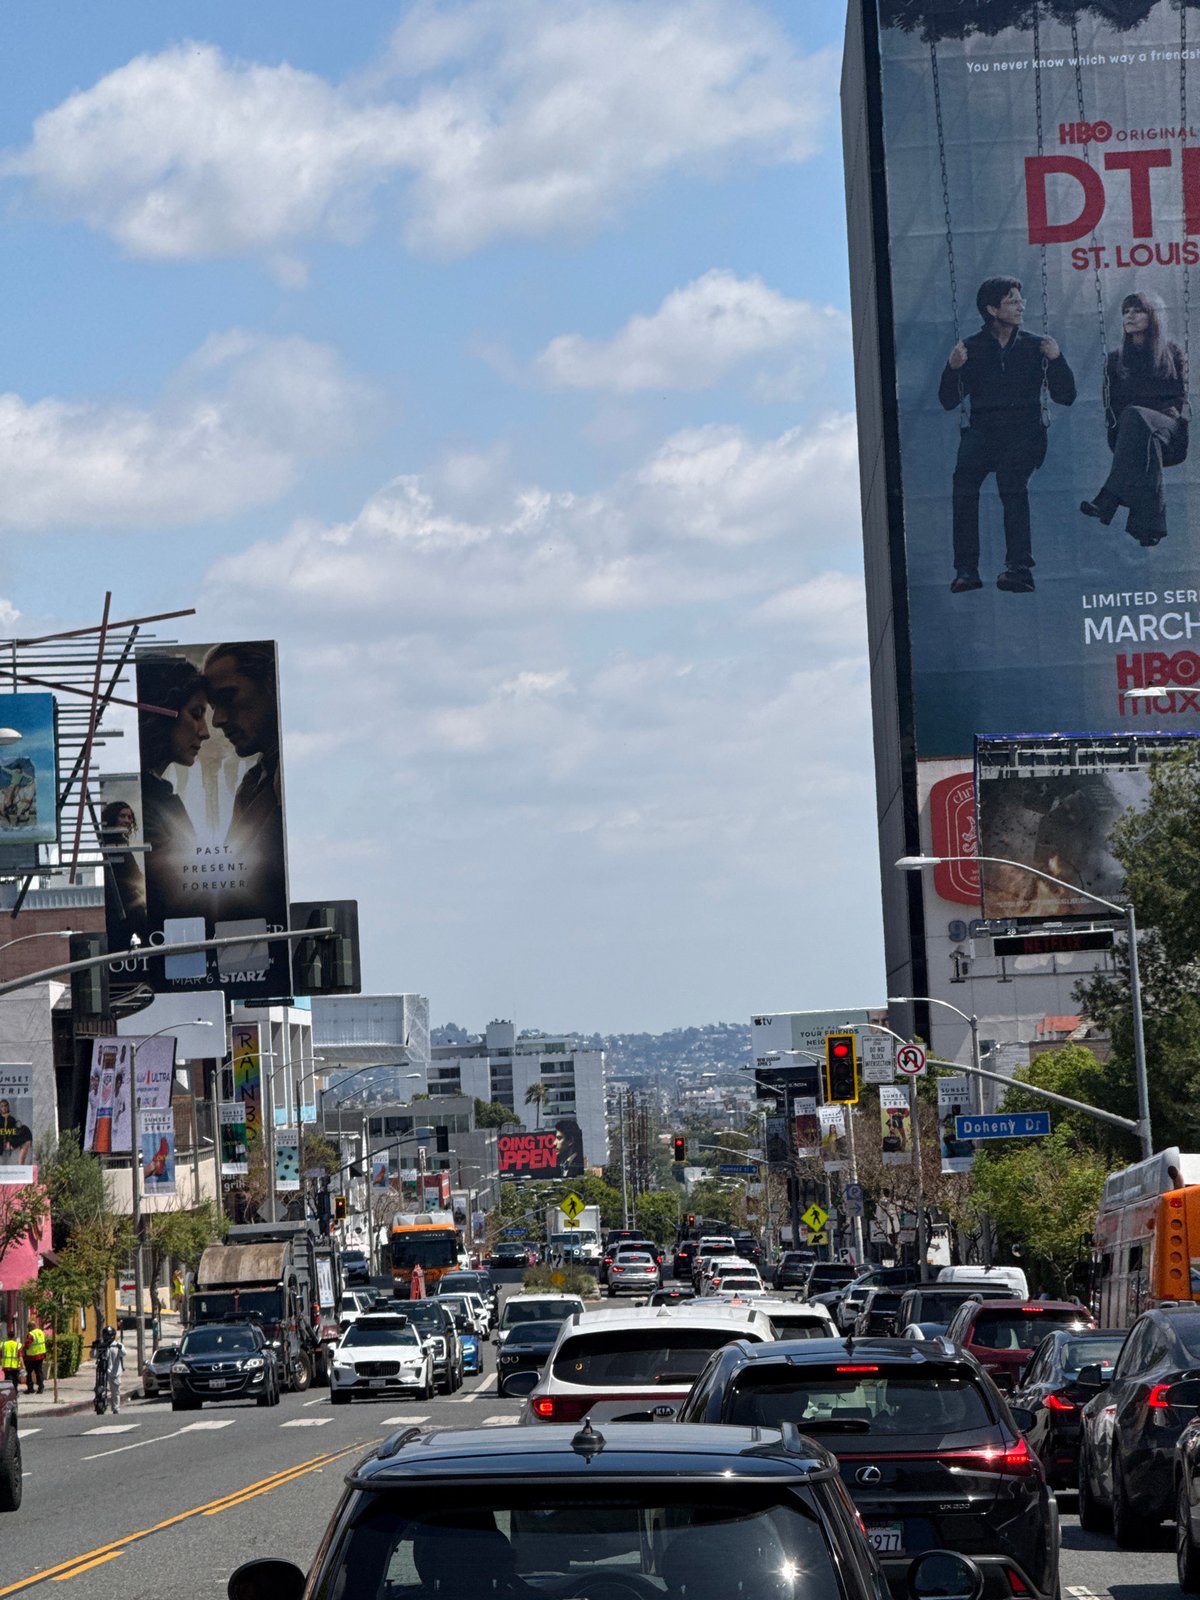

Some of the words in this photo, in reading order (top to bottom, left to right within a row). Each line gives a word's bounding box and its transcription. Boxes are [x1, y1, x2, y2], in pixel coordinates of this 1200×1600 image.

[966, 61, 989, 73] You
[993, 60, 1028, 71] never
[1032, 57, 1064, 69] know
[1068, 54, 1106, 67] which
[1109, 53, 1135, 65] way
[1138, 53, 1147, 62] a
[1058, 120, 1113, 144] HBO
[1116, 126, 1198, 142] ORIGINAL
[1071, 246, 1110, 270] ST.
[1116, 241, 1200, 268] LOUIS
[1082, 591, 1158, 609] LIMITED
[1084, 611, 1200, 644] MARCH
[1116, 650, 1200, 689] HBO
[196, 845, 233, 855] PAST.
[183, 862, 248, 873] PRESENT.
[182, 881, 248, 891] FOREVER.
[206, 972, 214, 983] 6
[219, 970, 267, 984] STARZ
[151, 1072, 171, 1082] ULTRA
[963, 1119, 1015, 1135] Doheny
[1025, 1118, 1041, 1131] Dr
[498, 1135, 535, 1151] OING
[537, 1134, 557, 1149] TO
[841, 1249, 849, 1258] P
[656, 1407, 672, 1415] KIA
